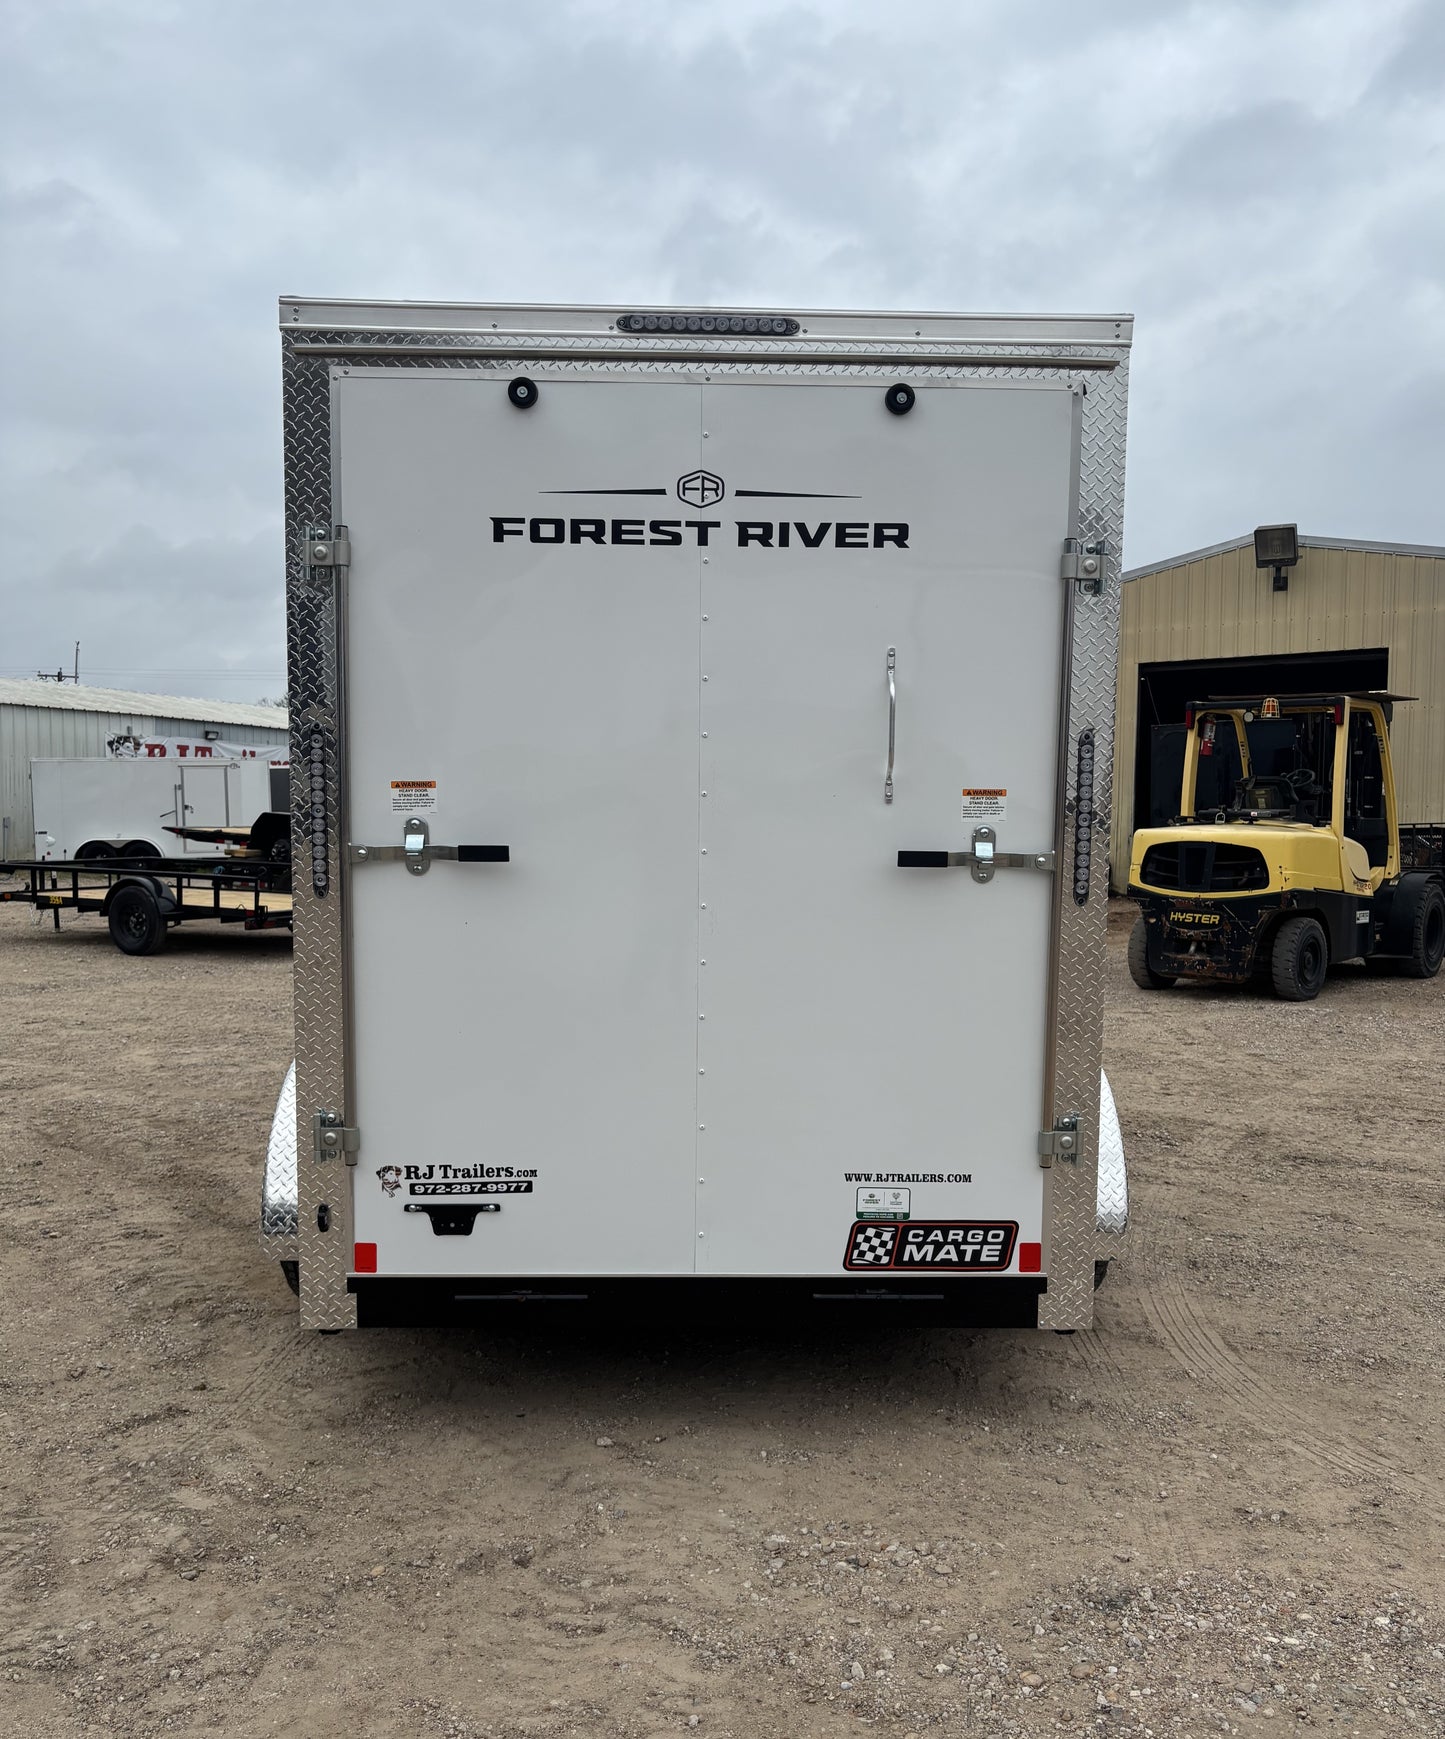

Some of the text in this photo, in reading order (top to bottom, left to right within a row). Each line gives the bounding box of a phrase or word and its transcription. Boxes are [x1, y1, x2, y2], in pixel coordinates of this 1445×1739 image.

[489, 516, 910, 549] FOREST RIVER
[1170, 911, 1220, 925] HYSTER
[404, 1164, 435, 1180] RJ
[844, 1173, 972, 1183] WWW.RJTRAILERS.COM
[414, 1182, 529, 1194] 972-287-9977
[907, 1229, 1005, 1243] CARGO
[902, 1244, 1002, 1262] MATE
